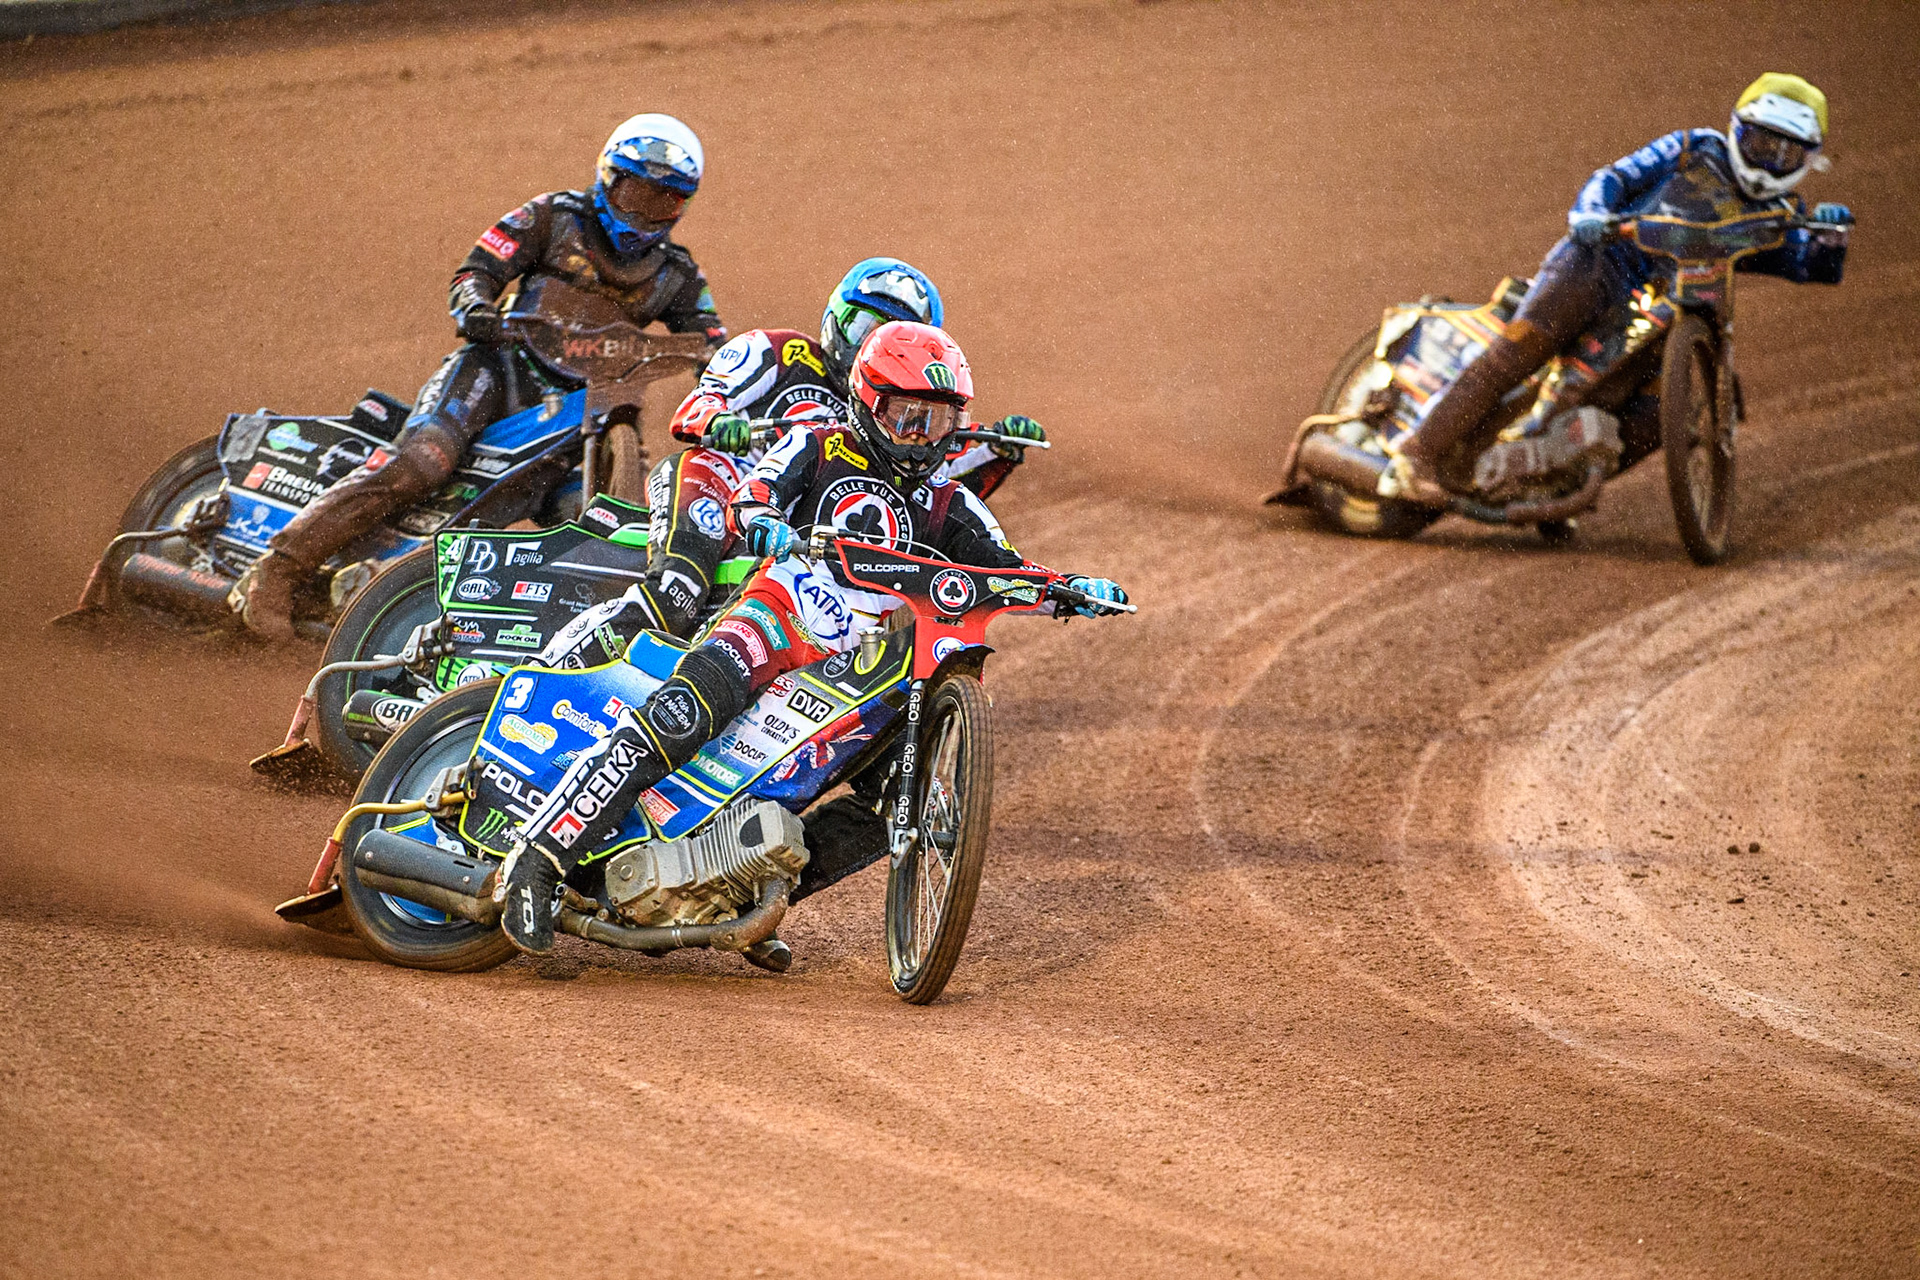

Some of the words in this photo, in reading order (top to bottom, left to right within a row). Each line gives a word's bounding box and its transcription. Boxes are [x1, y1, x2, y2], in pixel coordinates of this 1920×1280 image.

[785, 389, 822, 404] BELLE
[829, 481, 865, 501] BELLE
[871, 484, 896, 504] VUE
[894, 506, 909, 540] ACES
[445, 539, 460, 560] 4
[513, 552, 544, 566] agilia
[853, 562, 920, 573] POLCOPPER
[525, 583, 550, 596] FTS
[668, 585, 697, 619] agilia
[499, 634, 523, 642] ROCK
[523, 636, 539, 644] OIL
[721, 622, 753, 639] TRANS
[738, 604, 783, 648] MOTOREX
[714, 638, 752, 677] DOCUFY
[504, 677, 534, 709] 3
[790, 690, 830, 721] DVR
[908, 692, 921, 722] GEO
[382, 703, 416, 722] BA
[507, 718, 547, 746] AGROMIX
[764, 714, 801, 740] OLDY'S
[734, 740, 769, 763] DOCUFY
[902, 744, 915, 773] GEO
[574, 742, 646, 819] CELKA
[696, 755, 742, 787] MOTOREX
[896, 796, 910, 825] GEO
